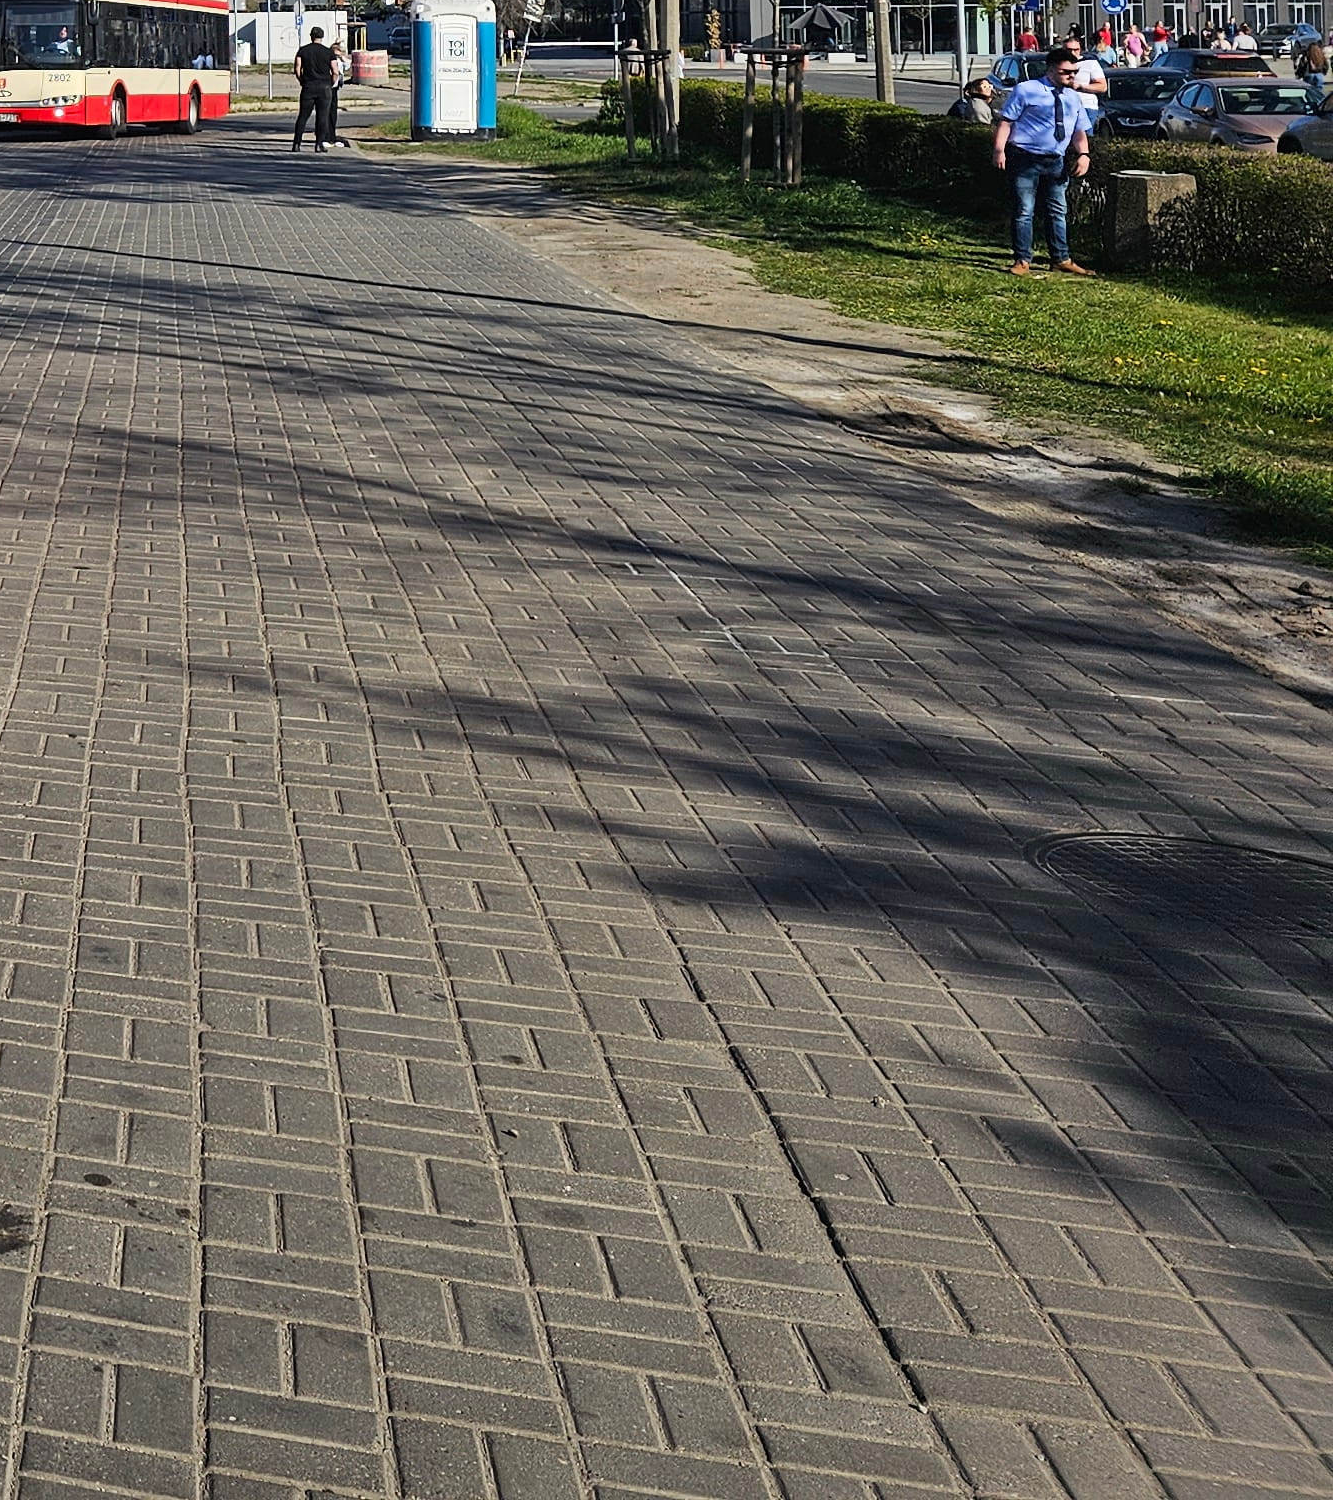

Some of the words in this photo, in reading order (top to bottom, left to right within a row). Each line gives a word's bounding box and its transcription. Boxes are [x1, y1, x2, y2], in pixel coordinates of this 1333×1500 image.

[448, 40, 465, 48] TOI
[448, 49, 465, 57] TOI
[48, 73, 71, 82] 2802
